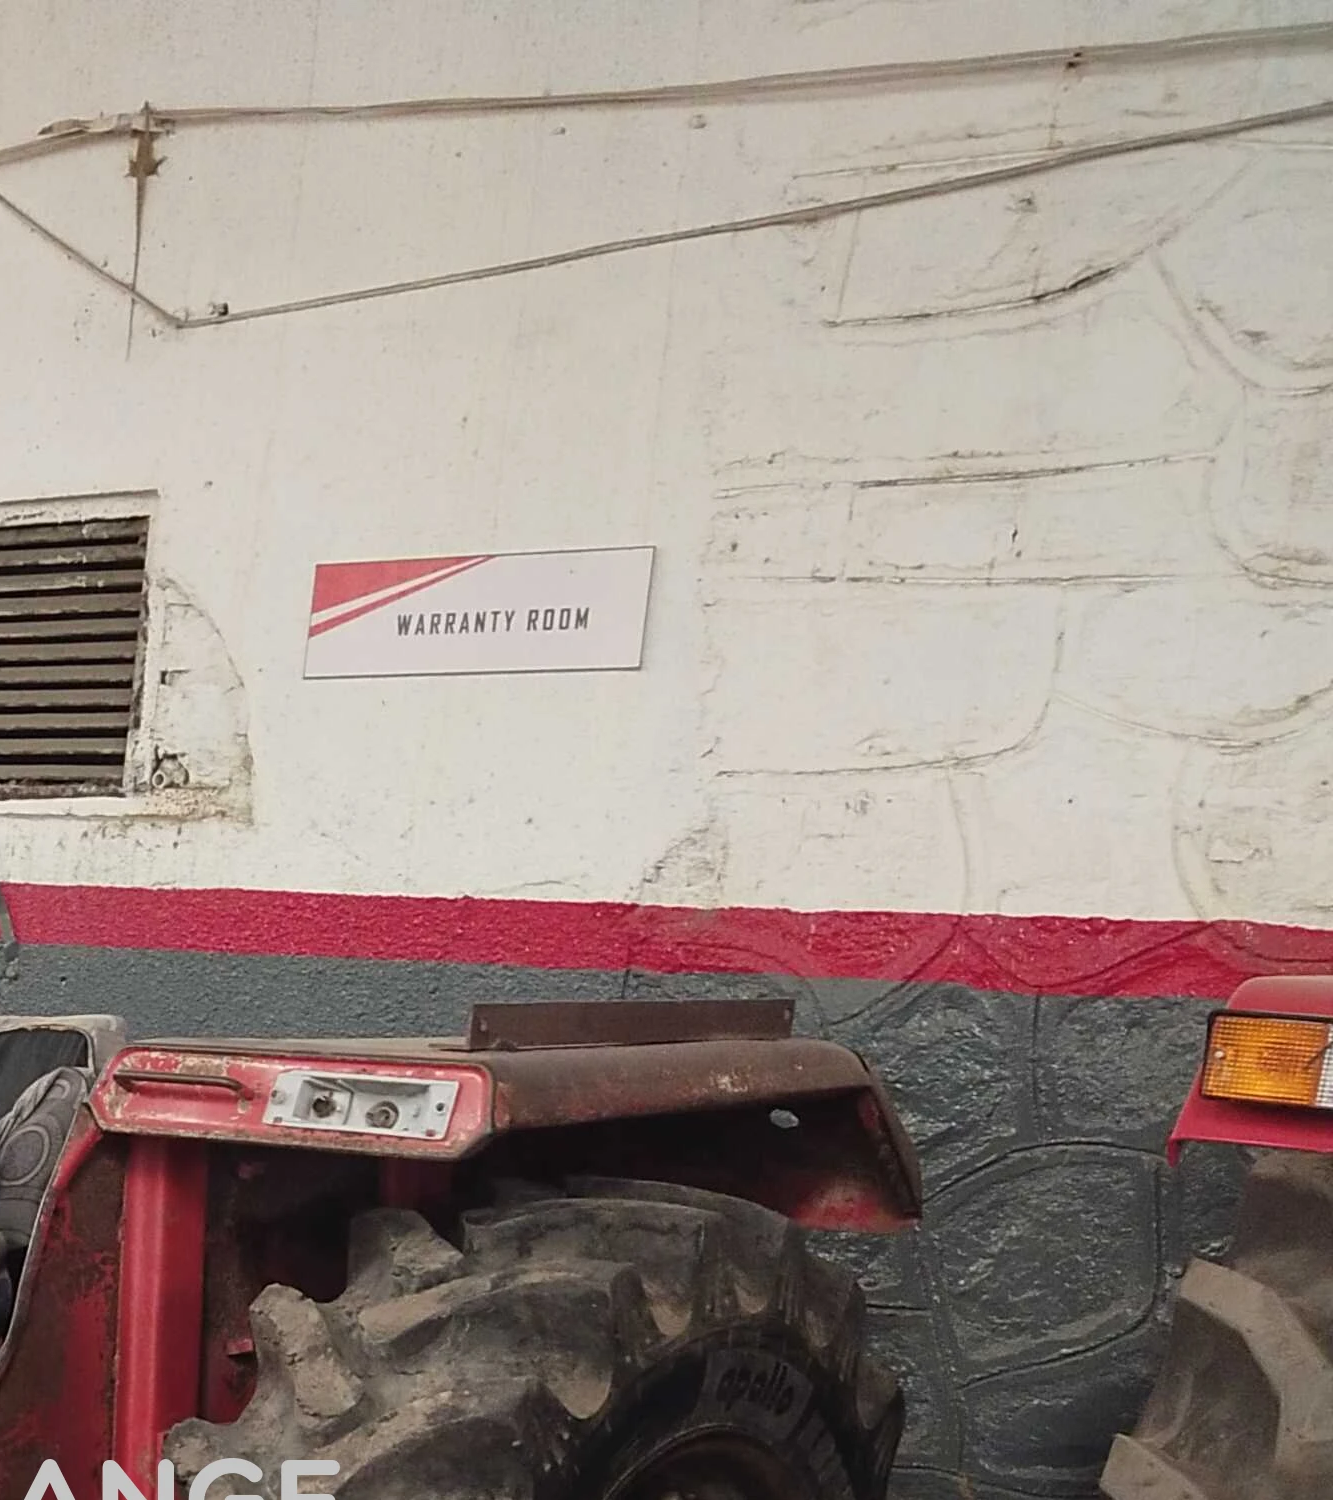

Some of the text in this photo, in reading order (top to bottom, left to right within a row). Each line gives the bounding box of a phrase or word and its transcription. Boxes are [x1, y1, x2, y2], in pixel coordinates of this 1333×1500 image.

[397, 607, 589, 636] WARRANTY ROOM
[715, 1360, 796, 1416] apollo
